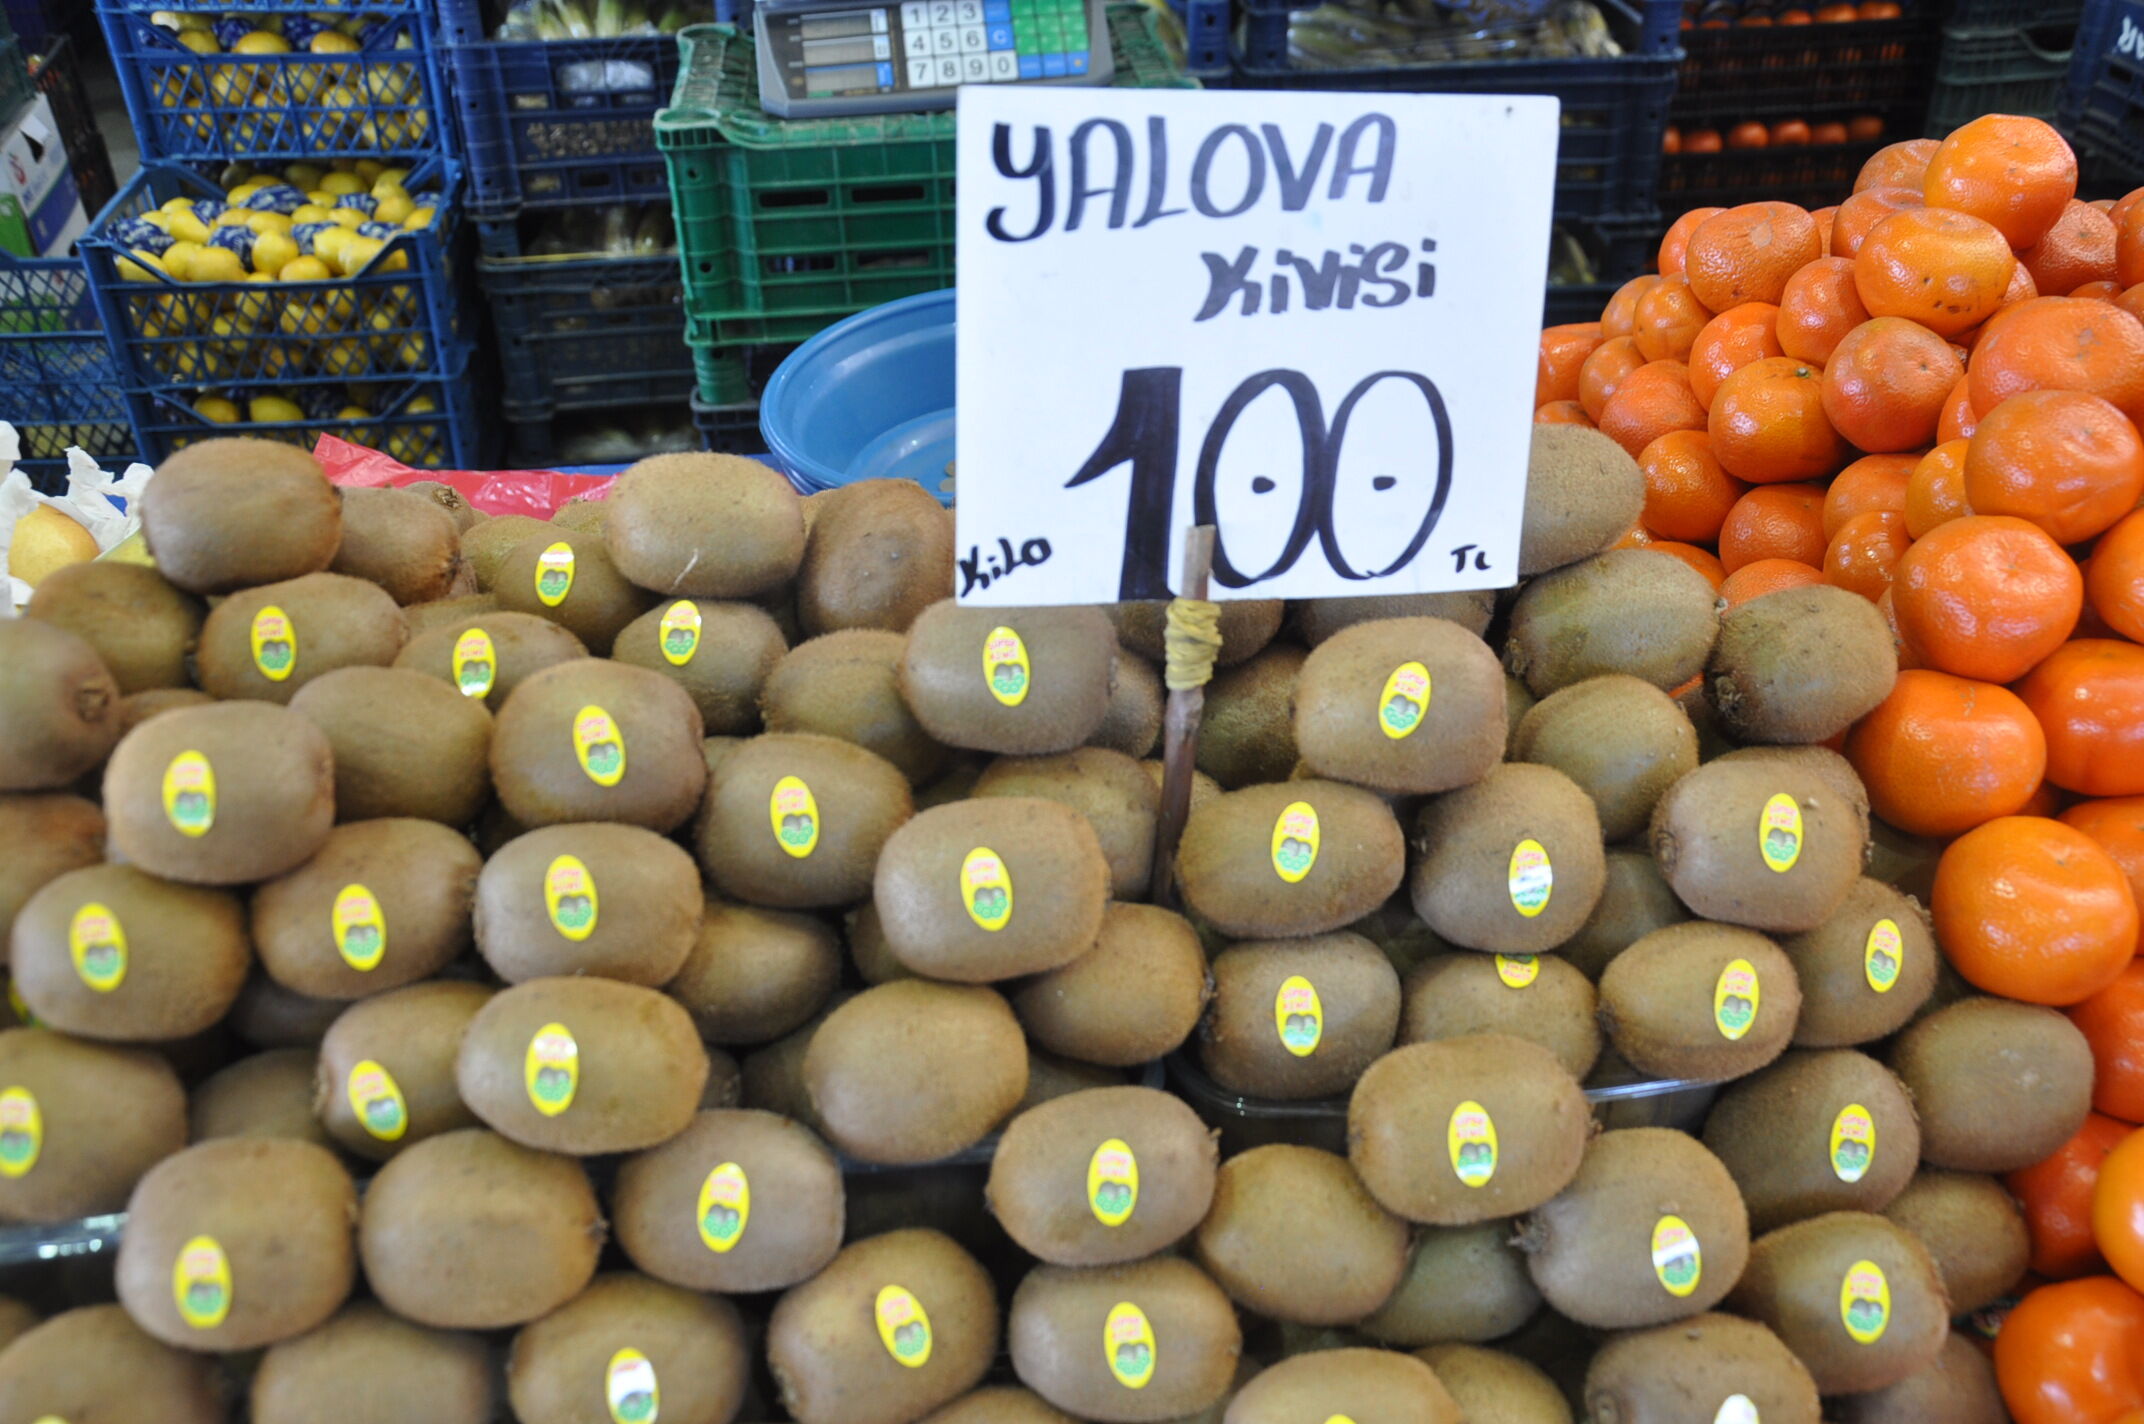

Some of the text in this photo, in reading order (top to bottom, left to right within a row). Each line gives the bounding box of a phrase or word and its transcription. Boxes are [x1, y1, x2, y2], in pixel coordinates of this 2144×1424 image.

[936, 5, 949, 22] 2
[963, 2, 976, 20] 3
[912, 30, 1007, 51] 4 5 6 C
[915, 57, 1010, 80] 7 8 9 0
[985, 112, 1397, 242] YALOVA
[1064, 366, 1454, 602] 100
